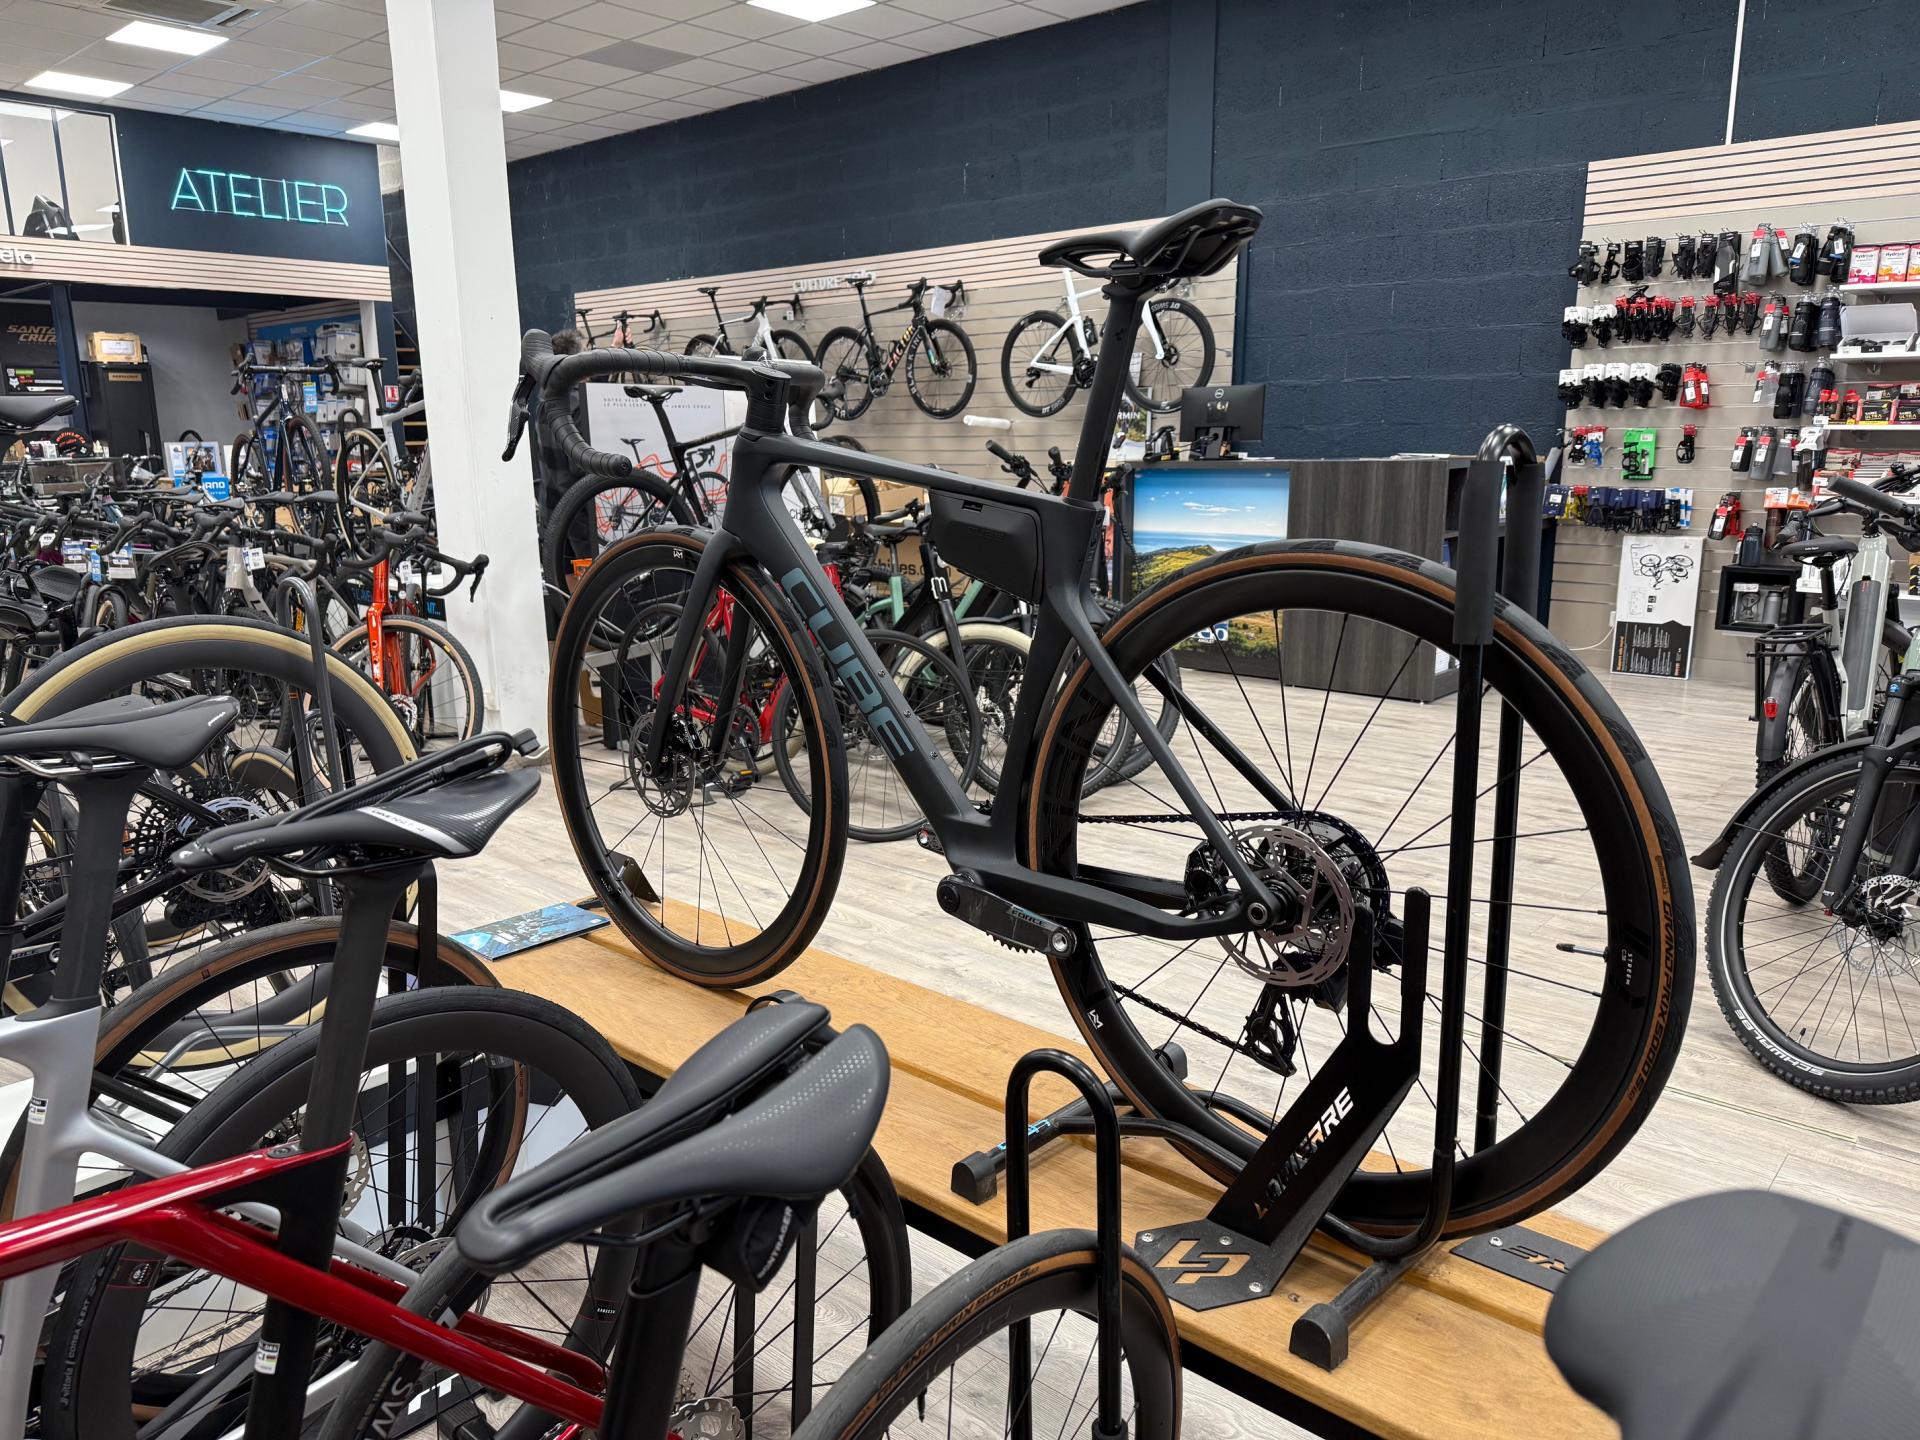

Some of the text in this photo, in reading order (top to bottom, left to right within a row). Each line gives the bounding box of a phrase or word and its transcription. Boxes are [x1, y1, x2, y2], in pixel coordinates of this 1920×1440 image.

[172, 168, 349, 227] ATELIER
[793, 276, 839, 293] CULTURE
[7, 324, 56, 334] SANTA
[19, 333, 57, 342] CRUZ
[1117, 411, 1140, 420] RMIN
[781, 567, 915, 761] CUBE
[1663, 900, 1676, 971] GRAND
[1656, 972, 1673, 1023] PRIX
[1642, 1023, 1664, 1077] 5000
[1735, 1009, 1825, 1076] SCHWALBE
